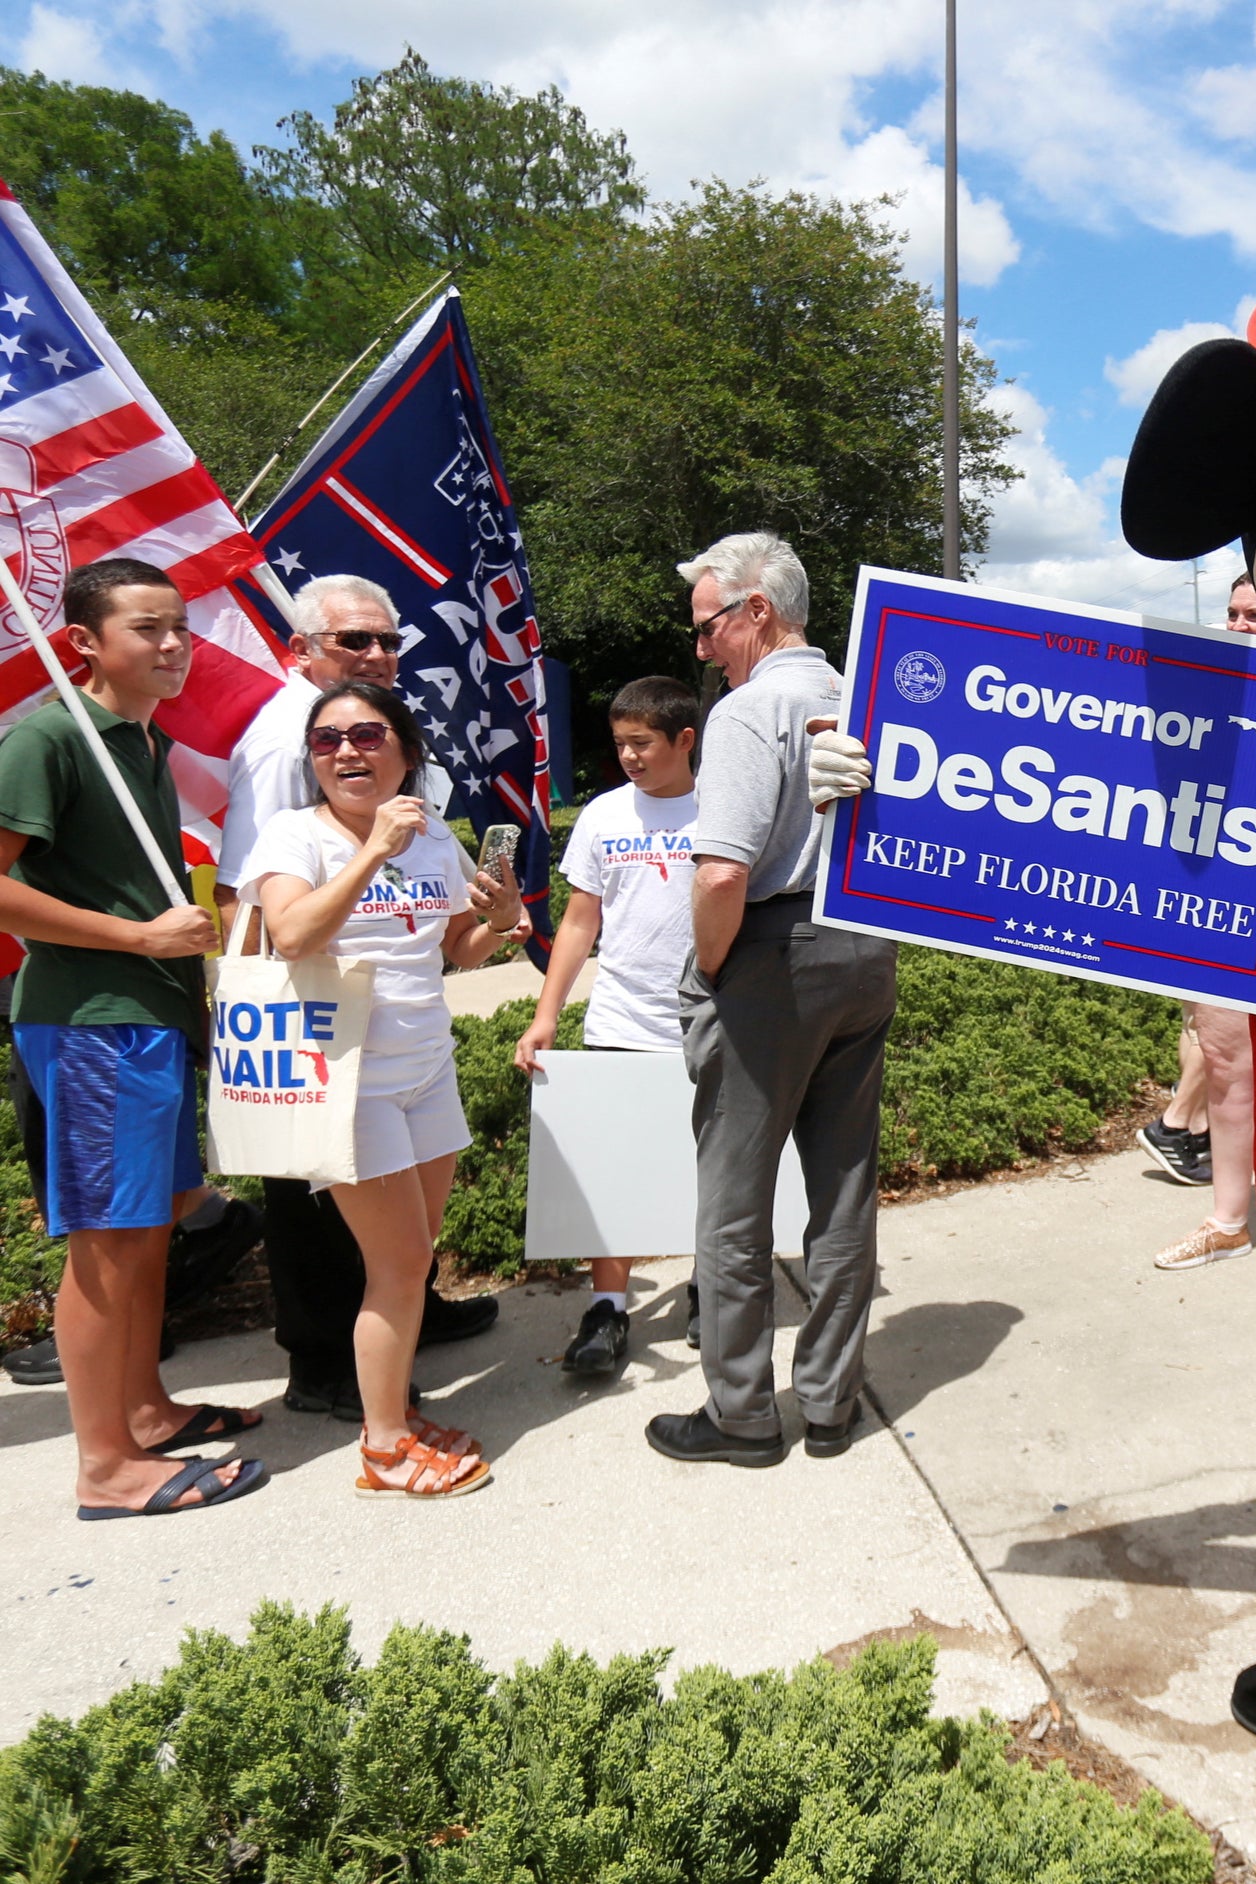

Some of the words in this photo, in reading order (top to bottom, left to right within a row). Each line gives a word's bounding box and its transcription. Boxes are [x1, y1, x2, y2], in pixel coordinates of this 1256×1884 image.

[1042, 632, 1099, 658] VOTE
[1106, 642, 1151, 667] FOR
[964, 664, 1213, 750] Governor
[602, 836, 652, 855] TOM
[608, 851, 662, 864] FLORIDA
[360, 884, 397, 902] OM
[406, 881, 448, 899] VAIL
[863, 831, 967, 879] KEEP
[975, 852, 1142, 916] FLORIDA
[1153, 888, 1256, 938] FREE
[351, 902, 411, 914] LORIDA
[993, 935, 1101, 962] www.trump2024swag.com
[213, 1046, 306, 1088] VAIL
[274, 1091, 327, 1105] HOUSE
